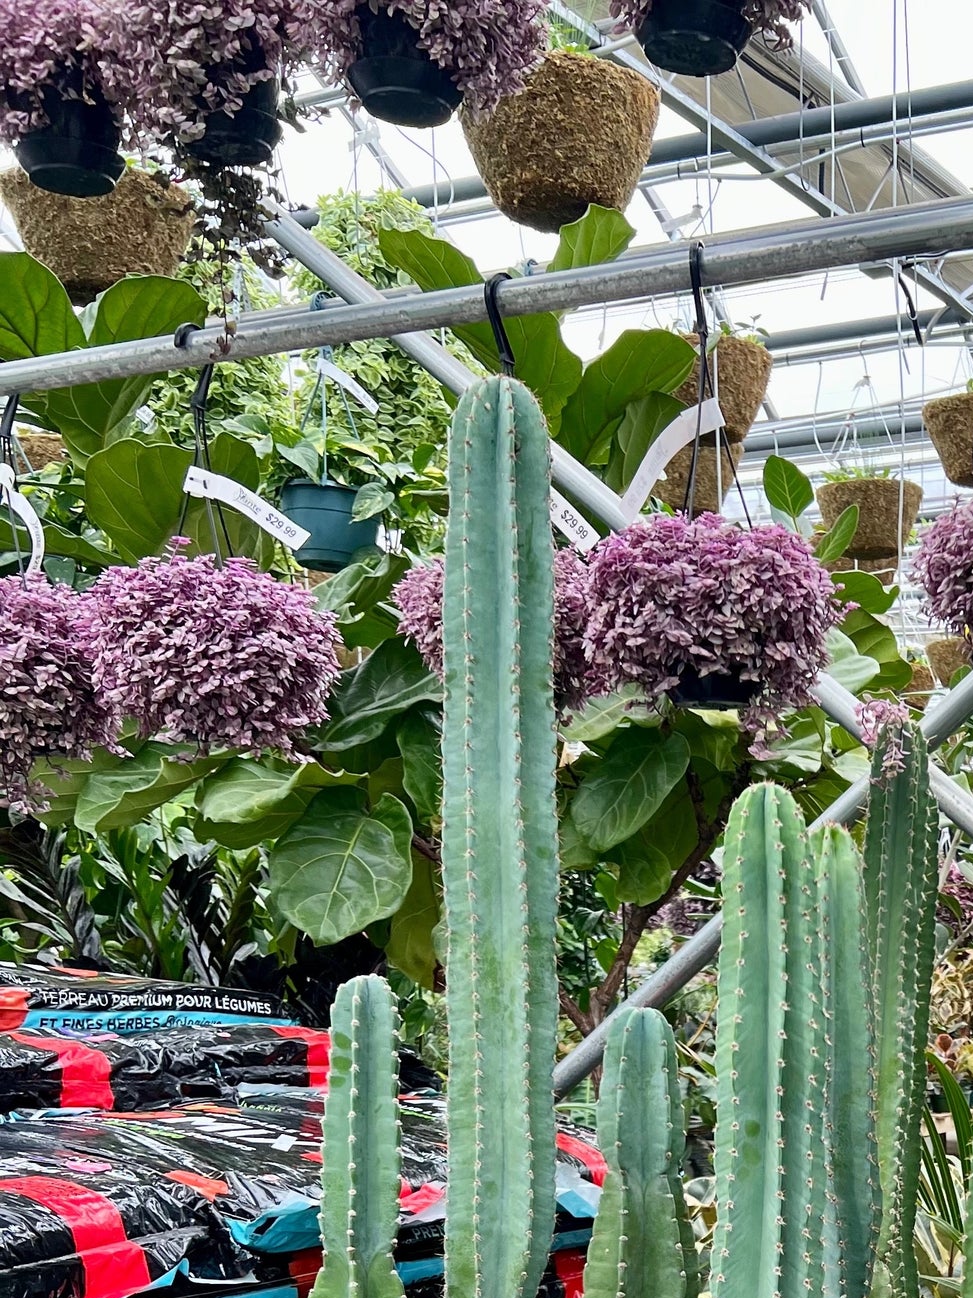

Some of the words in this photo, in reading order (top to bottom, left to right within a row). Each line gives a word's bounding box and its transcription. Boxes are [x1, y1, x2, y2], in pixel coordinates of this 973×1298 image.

[40, 991, 109, 1007] TERREAU
[111, 993, 173, 1008] PREMIUM
[176, 995, 212, 1009] POUR
[215, 995, 272, 1015] LÉGUMES
[62, 1017, 103, 1030] FINES
[106, 1016, 160, 1031] HERBES
